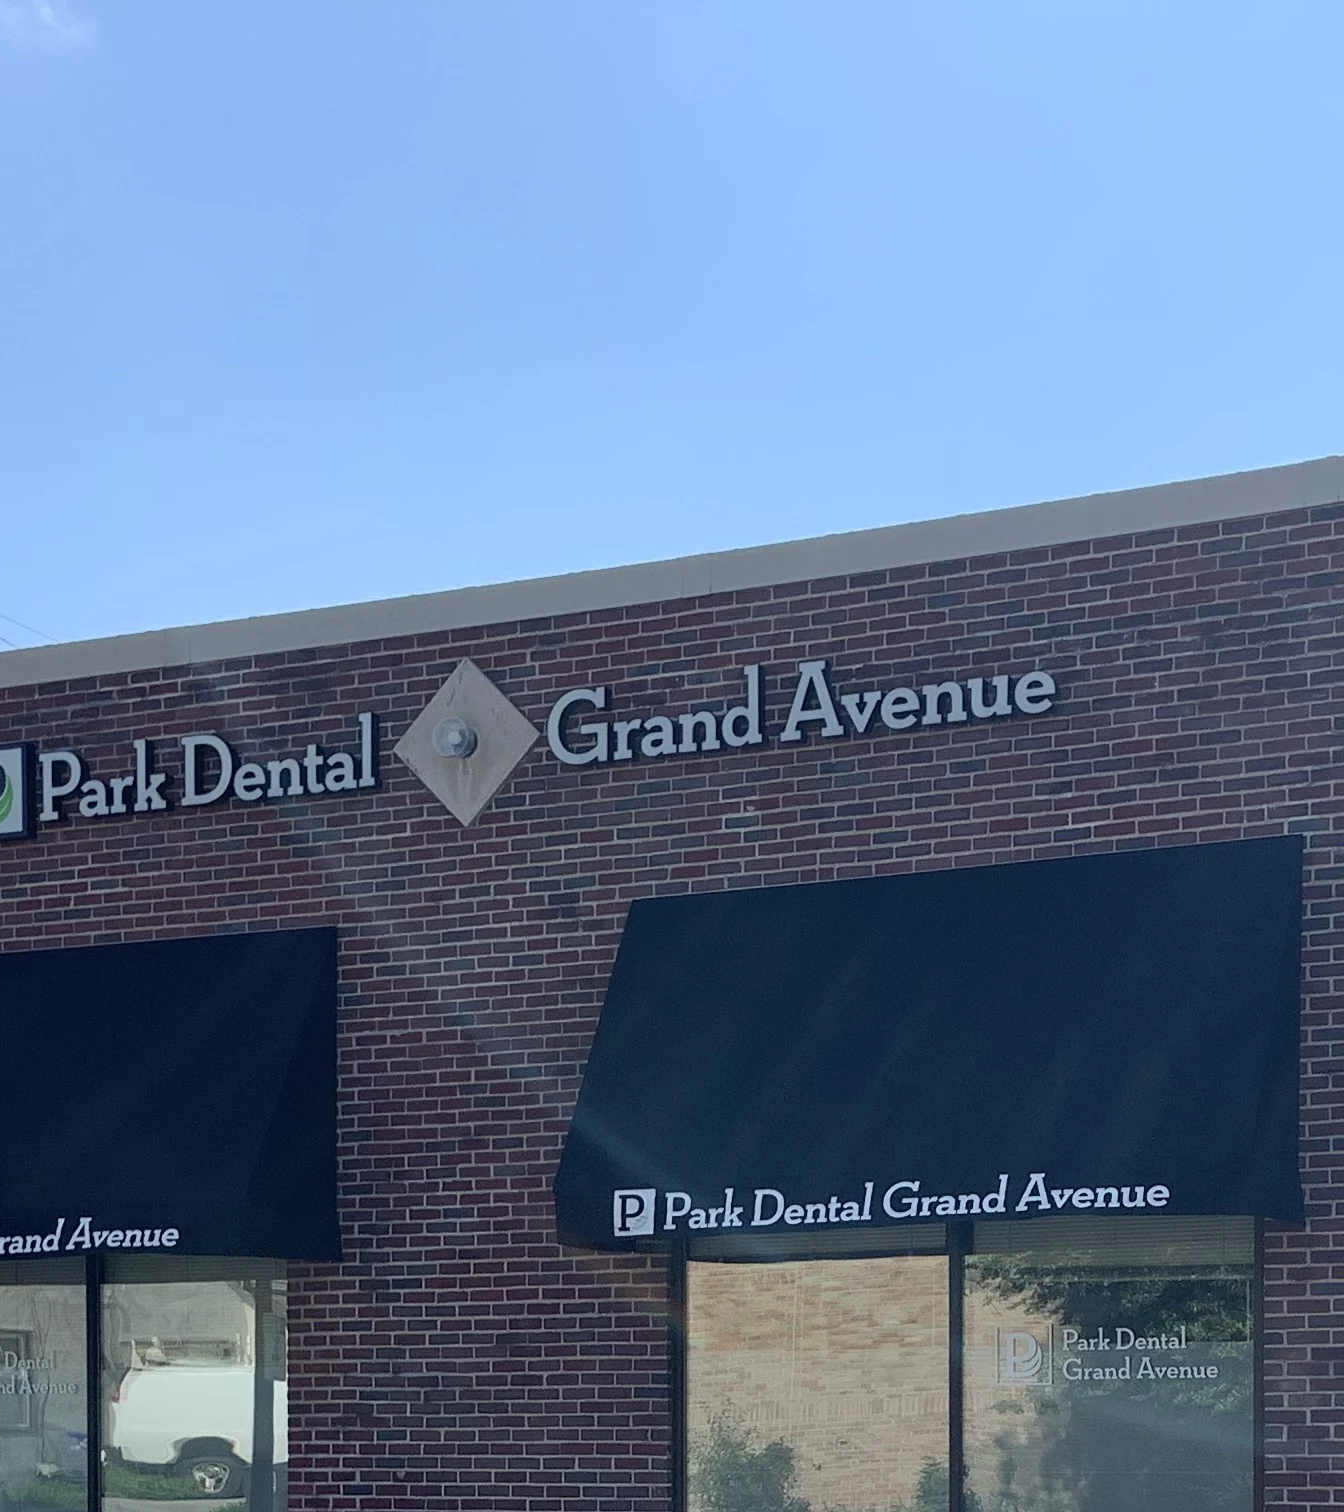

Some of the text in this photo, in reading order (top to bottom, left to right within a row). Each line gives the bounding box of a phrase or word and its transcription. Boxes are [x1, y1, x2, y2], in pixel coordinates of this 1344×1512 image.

[39, 739, 167, 822] Park
[180, 711, 377, 807] Dental
[547, 663, 763, 765] Grand
[780, 660, 1056, 742] Avenue
[663, 1188, 743, 1230] Park
[751, 1181, 874, 1227] Dental
[882, 1174, 1010, 1220] Grand
[1015, 1173, 1170, 1212] Avenue
[65, 1216, 180, 1250] Avenue
[1062, 1326, 1187, 1351] Park Dental
[5, 1350, 54, 1370] Dental
[1062, 1356, 1219, 1380] Grand Avenue
[18, 1375, 79, 1395] Avenue
